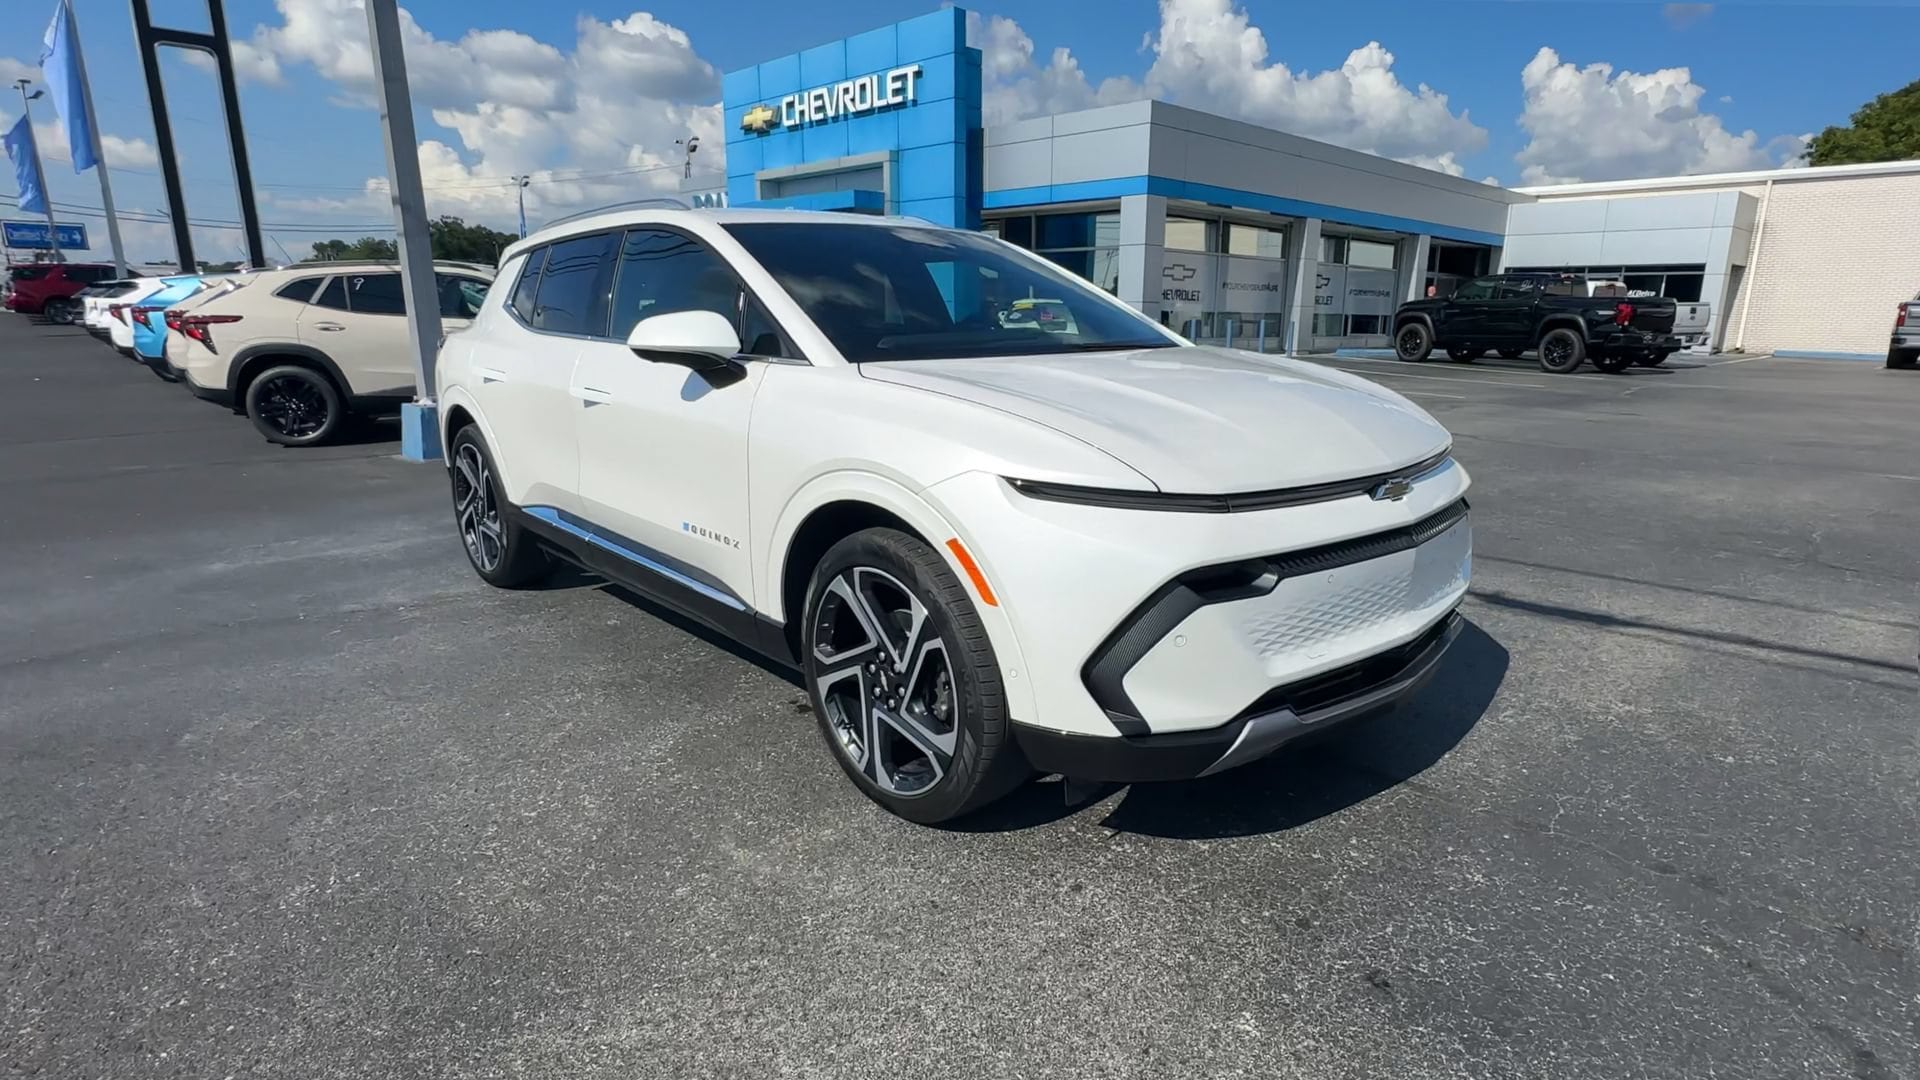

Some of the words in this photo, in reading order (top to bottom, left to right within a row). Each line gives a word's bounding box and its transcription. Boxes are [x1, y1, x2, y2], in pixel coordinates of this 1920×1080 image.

[781, 64, 919, 127] CHEVROLET
[354, 277, 365, 290] 9
[1161, 289, 1200, 302] HEVROLET
[683, 522, 740, 549] EQUINOX
